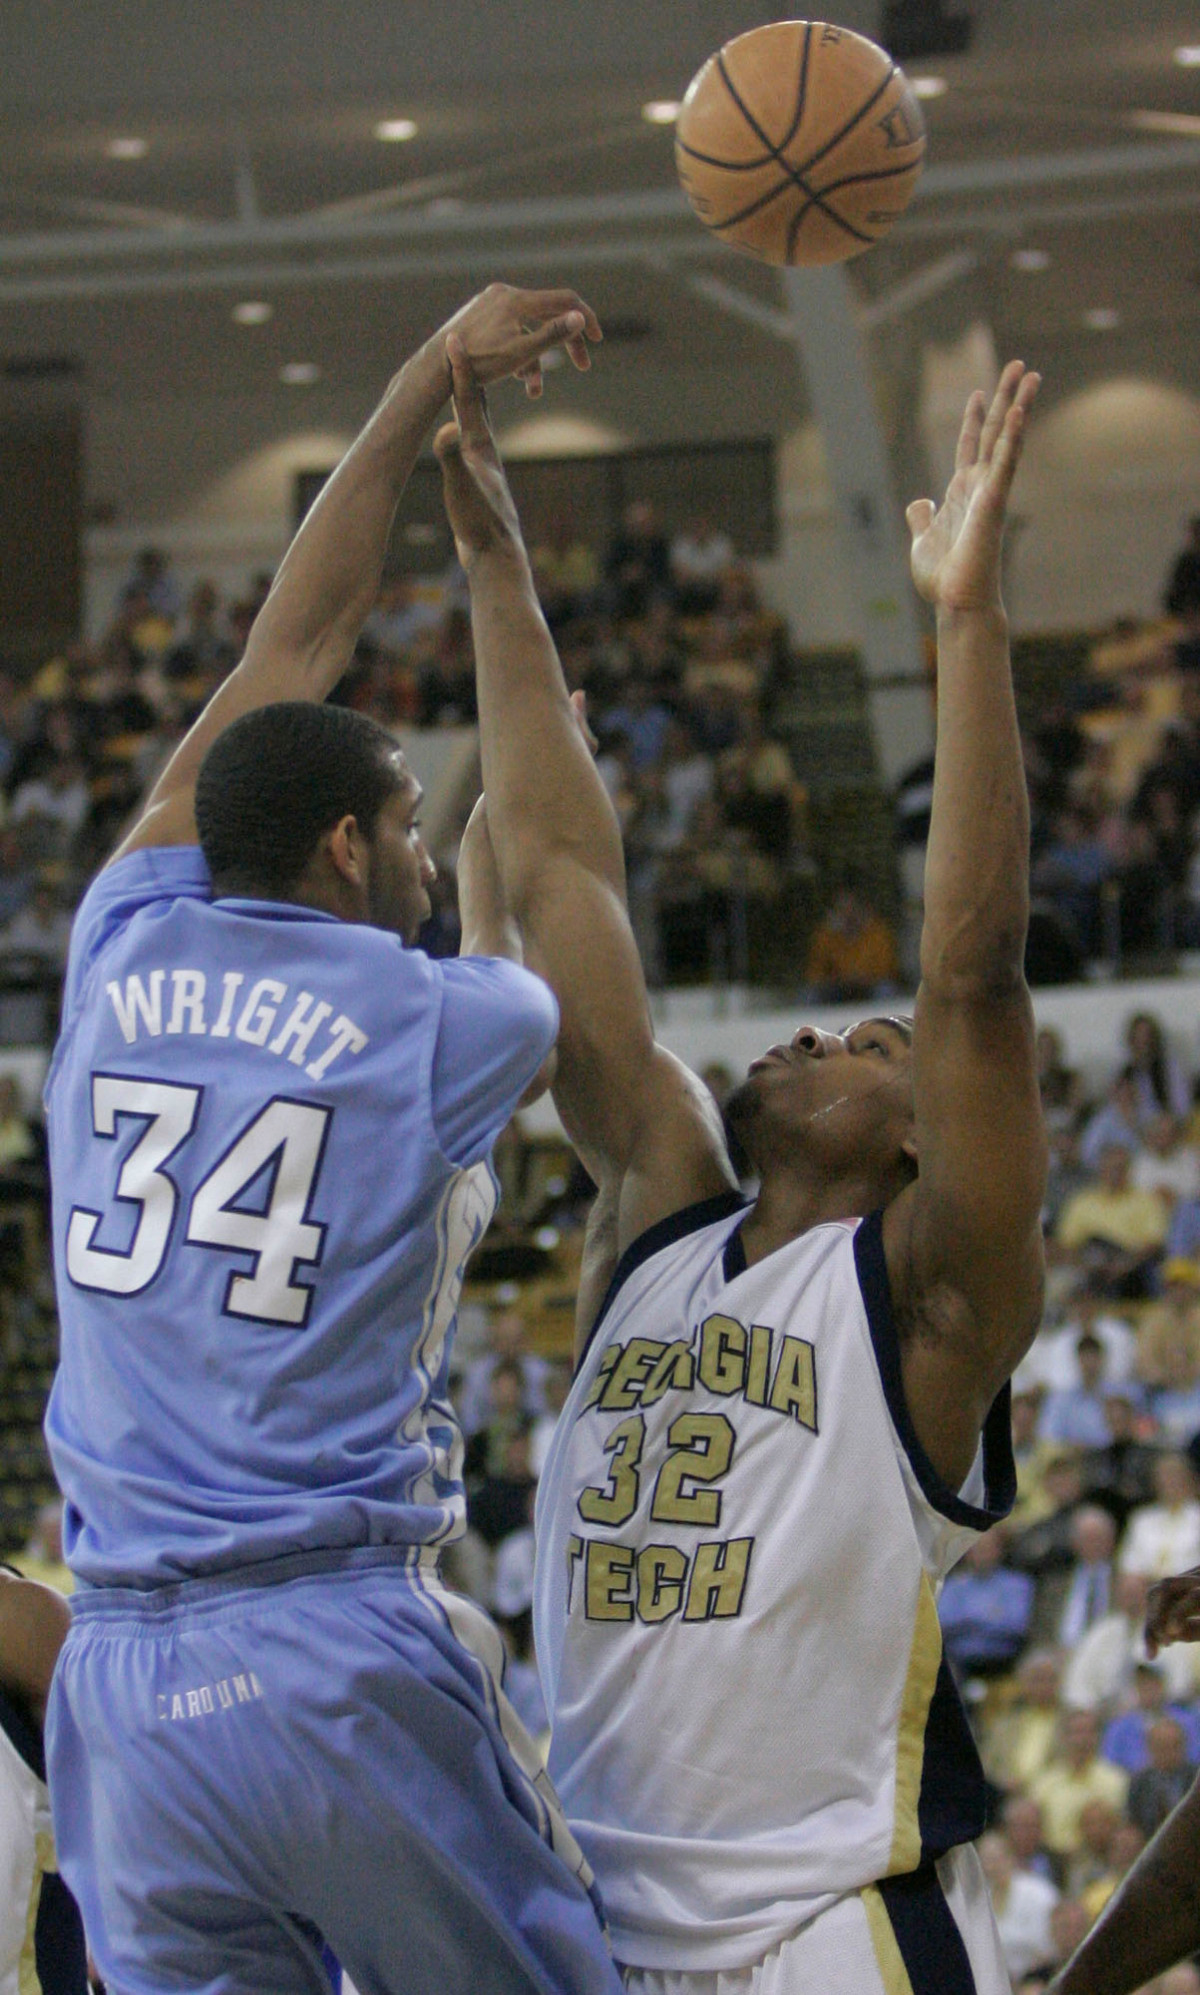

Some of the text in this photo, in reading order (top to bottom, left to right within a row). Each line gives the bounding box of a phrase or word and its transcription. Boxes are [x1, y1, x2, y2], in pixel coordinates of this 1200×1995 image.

[108, 969, 369, 1082] WRIGHT
[66, 1071, 335, 1329] 34
[577, 1412, 736, 1527] 32
